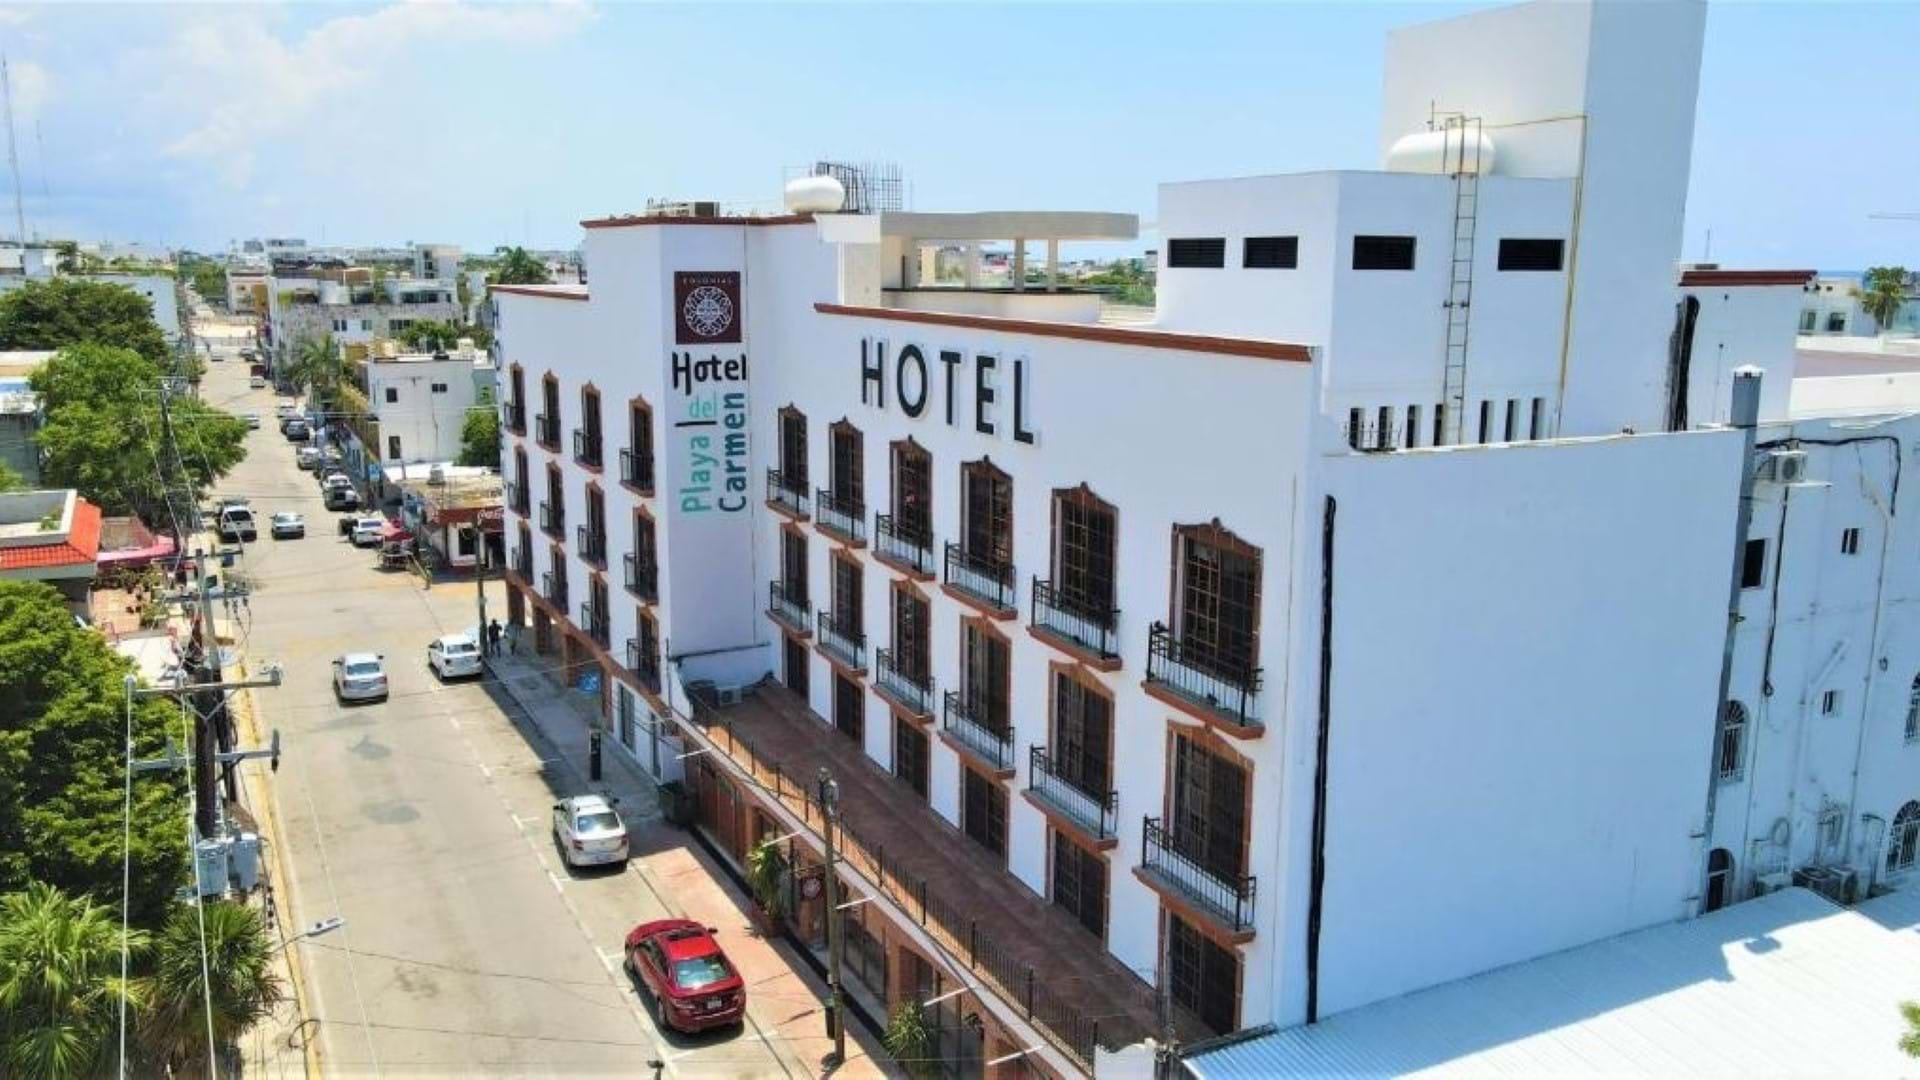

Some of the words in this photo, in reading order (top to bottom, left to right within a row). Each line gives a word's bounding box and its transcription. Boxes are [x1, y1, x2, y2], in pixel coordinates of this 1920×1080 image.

[672, 351, 747, 396] Hotel
[689, 391, 718, 418] del
[861, 337, 1035, 445] HOTEL
[680, 435, 720, 513] Playa
[717, 393, 747, 513] Carmen
